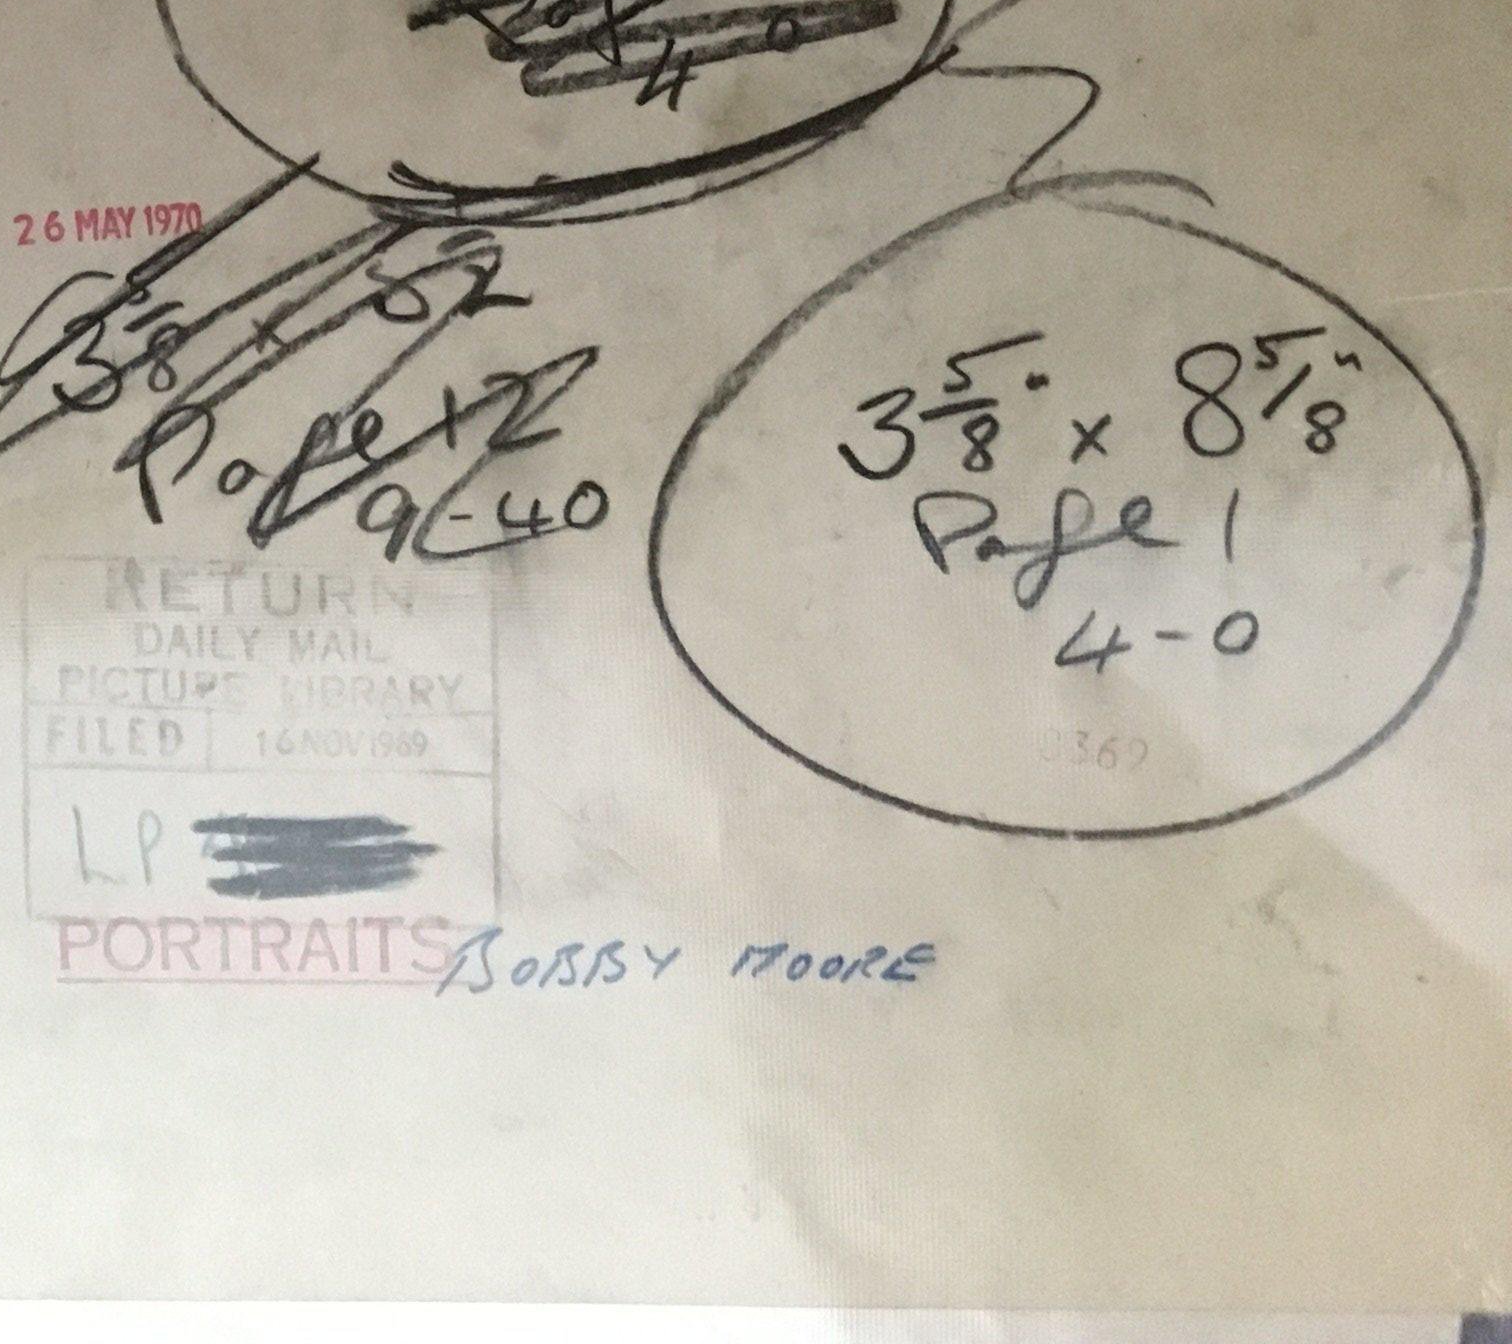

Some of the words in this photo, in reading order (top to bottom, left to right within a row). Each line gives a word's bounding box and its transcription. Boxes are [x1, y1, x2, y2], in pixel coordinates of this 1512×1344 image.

[14, 211, 65, 245] 26
[76, 206, 139, 241] MAY
[144, 202, 204, 236] 1970
[913, 487, 1181, 610] Page
[104, 557, 416, 616] RETURN
[134, 621, 262, 662] DAILY
[288, 628, 391, 664] MAIL
[47, 716, 185, 758] FILED
[58, 915, 456, 975] PORTRAITS
[435, 926, 682, 996] BOBBY
